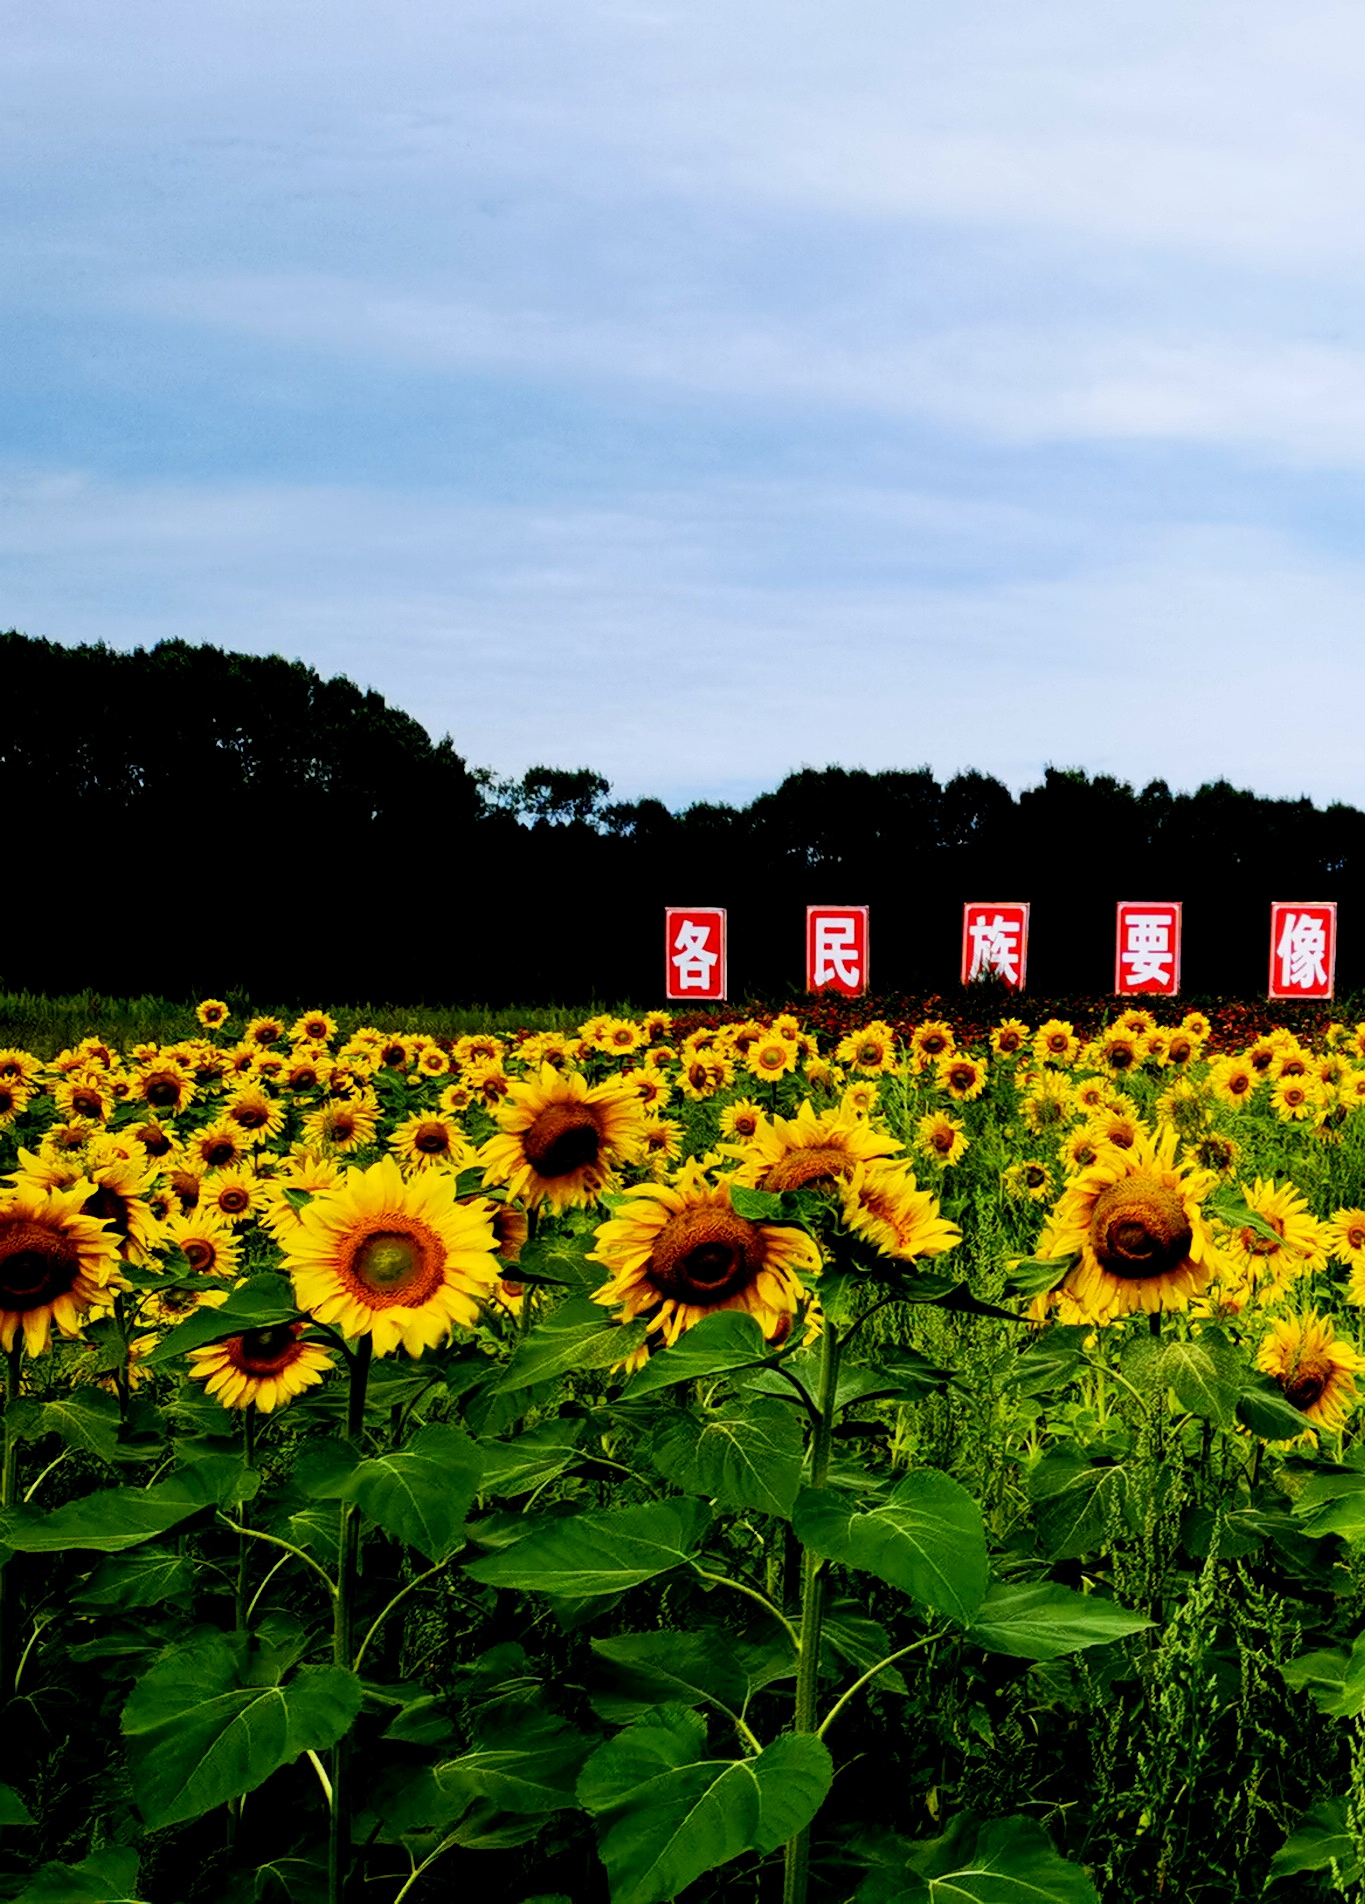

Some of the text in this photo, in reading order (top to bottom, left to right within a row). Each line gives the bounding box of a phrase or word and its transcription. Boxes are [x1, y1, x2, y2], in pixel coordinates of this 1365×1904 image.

[672, 920, 718, 990] 各
[814, 918, 860, 987] 民
[1123, 915, 1172, 985] 要
[1277, 913, 1326, 989] 像
